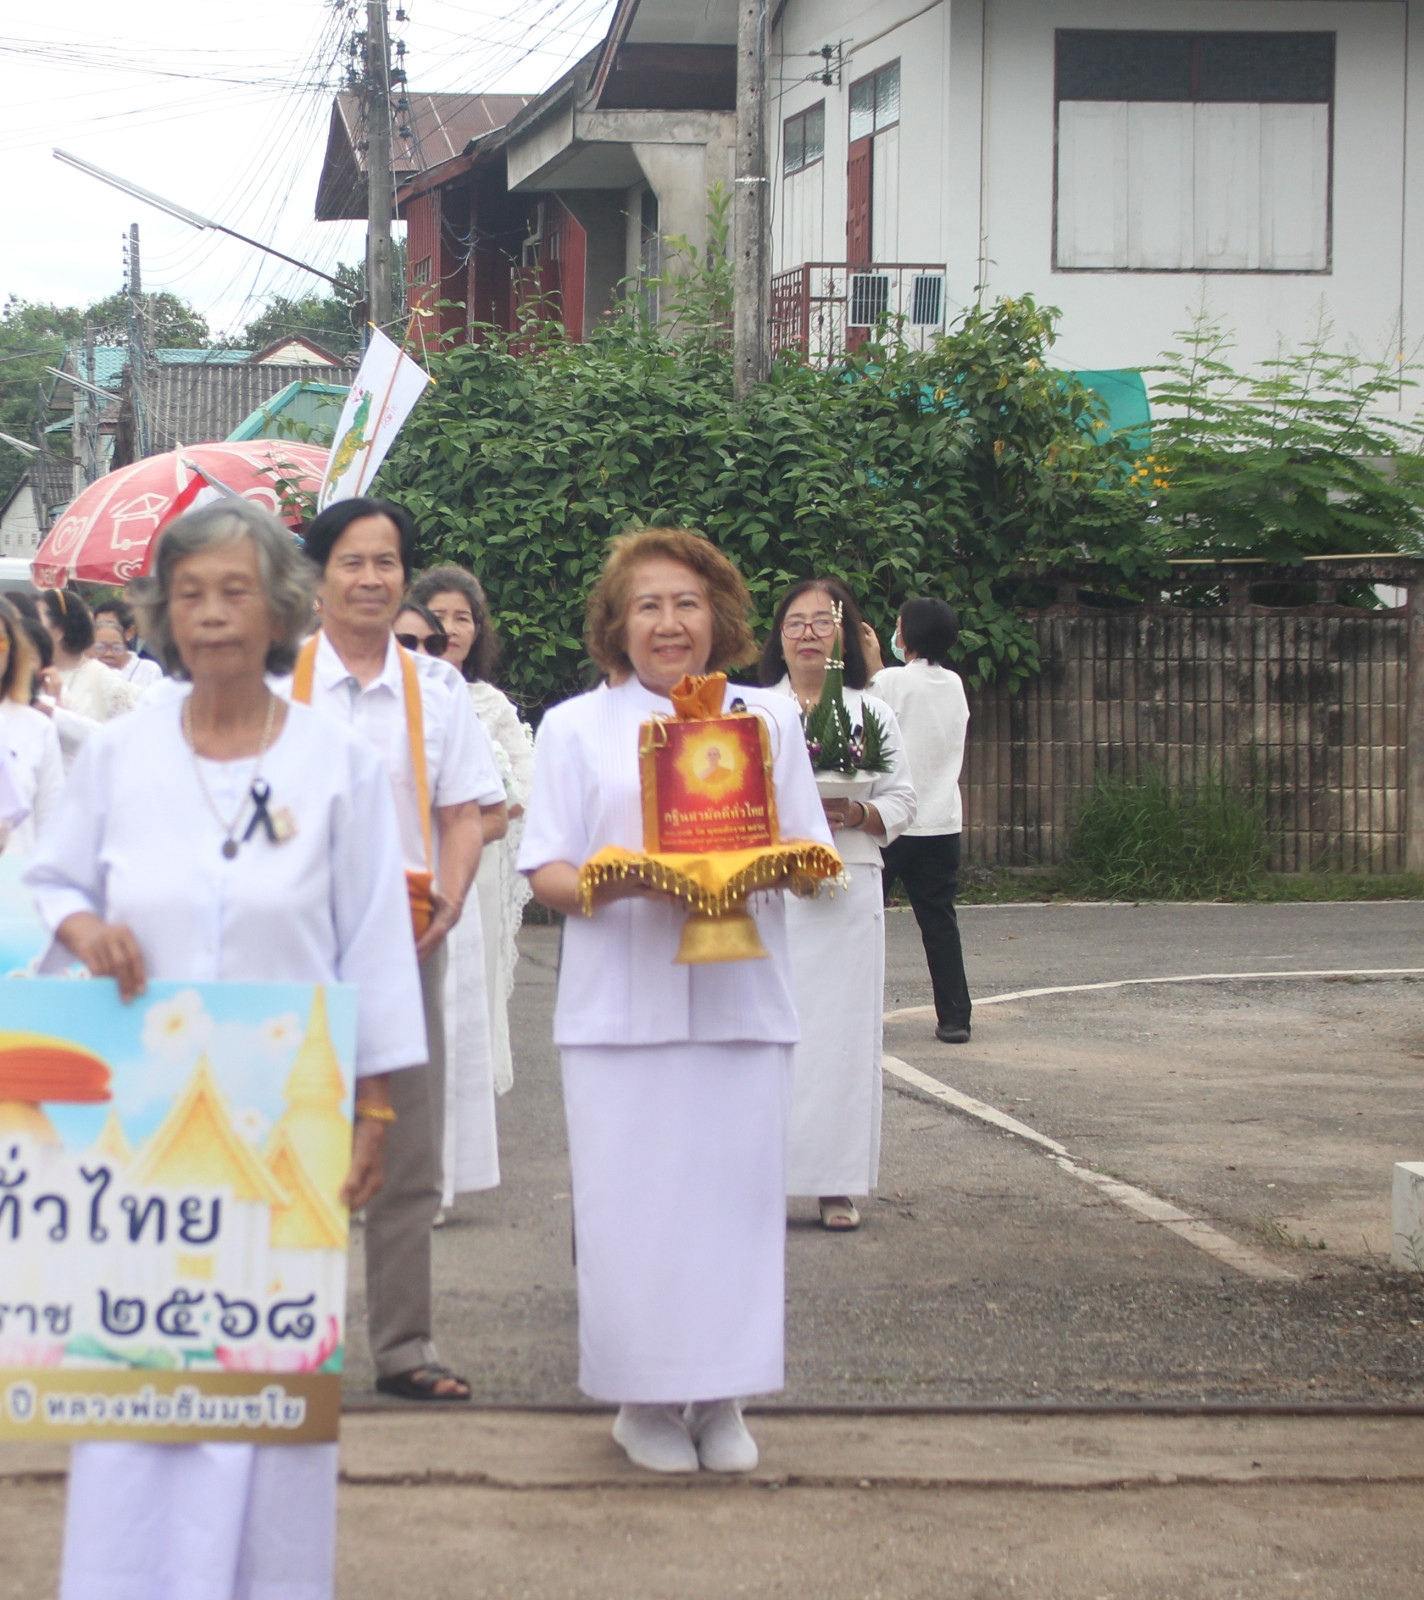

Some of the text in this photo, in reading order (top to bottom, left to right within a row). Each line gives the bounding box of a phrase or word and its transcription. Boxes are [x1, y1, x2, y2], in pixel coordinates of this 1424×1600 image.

[97, 1285, 318, 1341] ๒๕๖๘
[10, 1384, 35, 1419] ปี
[45, 1386, 305, 1425] หลวงพ่อธัมมชโย
